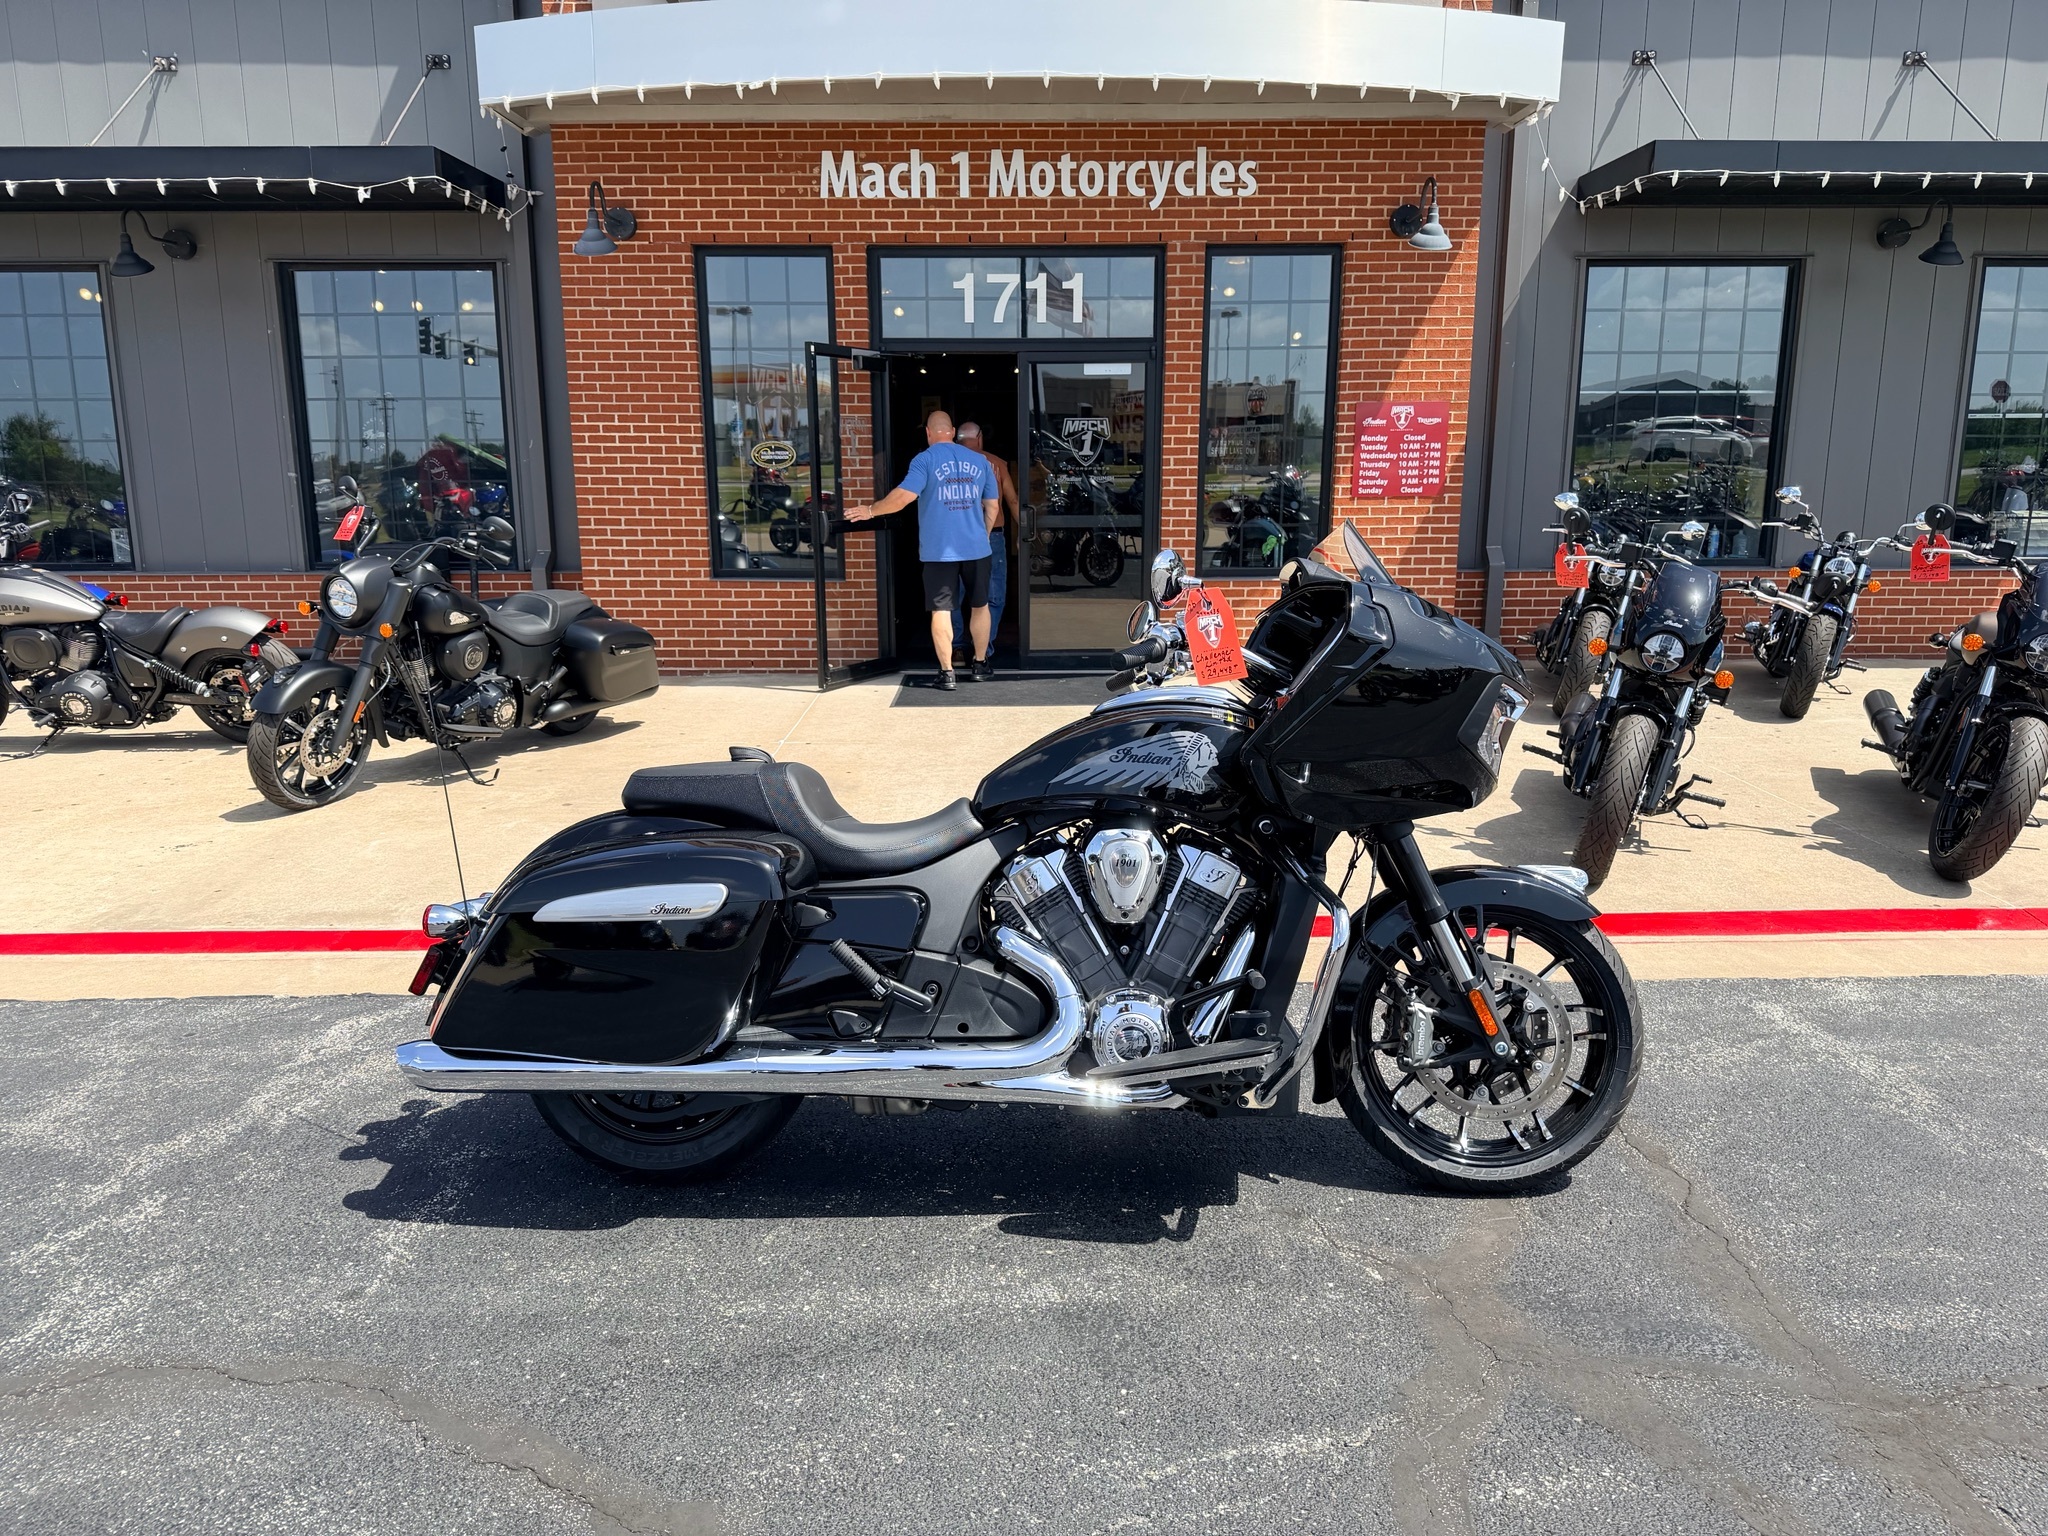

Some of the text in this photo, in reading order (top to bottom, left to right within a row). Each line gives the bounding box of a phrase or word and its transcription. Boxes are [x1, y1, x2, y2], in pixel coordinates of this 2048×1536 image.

[820, 146, 1258, 211] Mach 1 Motorcycles
[953, 272, 1084, 324] 1711
[1064, 420, 1109, 436] MACH
[1079, 430, 1094, 456] 1
[1361, 435, 1388, 443] Monday
[1360, 452, 1397, 460] Wednesday
[958, 461, 982, 480] 1901
[1360, 461, 1390, 469] Thursday
[1359, 478, 1388, 486] Saturday
[938, 484, 980, 501] INDIAN
[0, 604, 30, 613] DIAN
[1198, 614, 1223, 631] MACH
[1208, 623, 1218, 642] 1
[1196, 649, 1234, 663] Challenger
[1109, 746, 1173, 765] Indian
[1115, 857, 1138, 868] 1901
[650, 902, 692, 915] Indian
[1106, 1023, 1120, 1060] INDIAN
[1416, 1020, 1426, 1056] brembo
